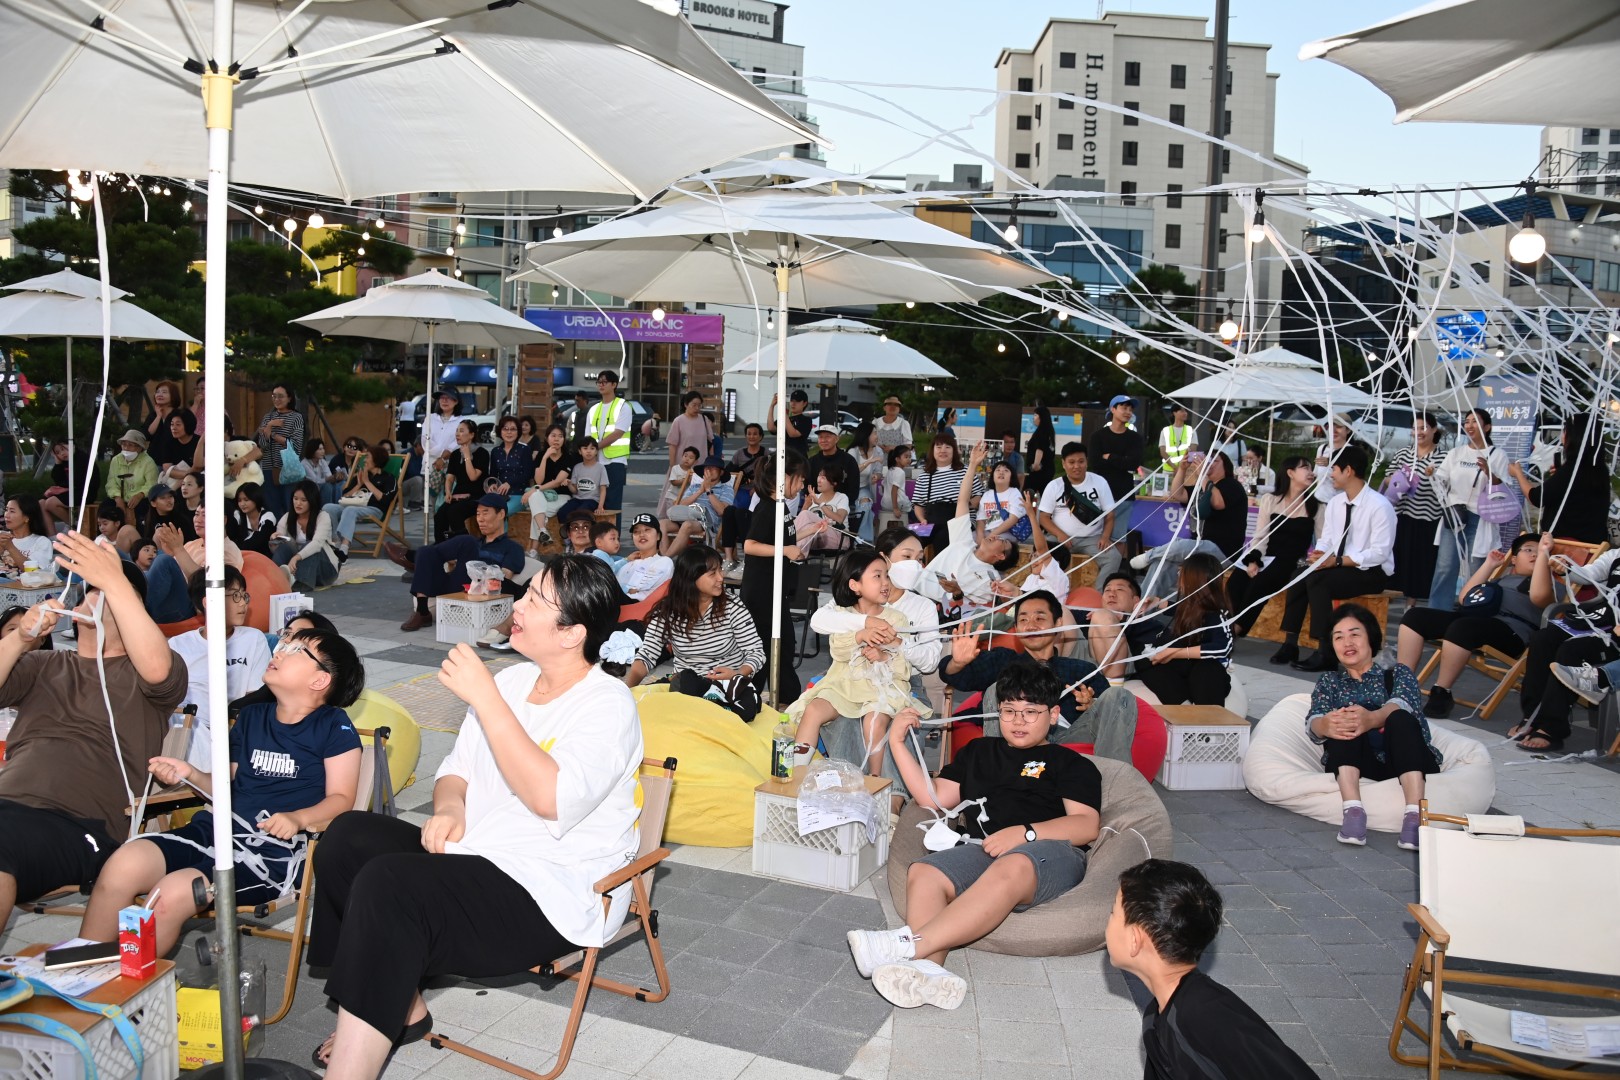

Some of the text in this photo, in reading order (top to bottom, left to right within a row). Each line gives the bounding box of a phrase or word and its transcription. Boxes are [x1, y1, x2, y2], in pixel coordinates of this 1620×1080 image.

[693, 1, 770, 25] BROOKS HOTEL
[1083, 53, 1104, 178] H.moment
[564, 315, 616, 328] URBAN
[252, 754, 296, 775] PUMA
